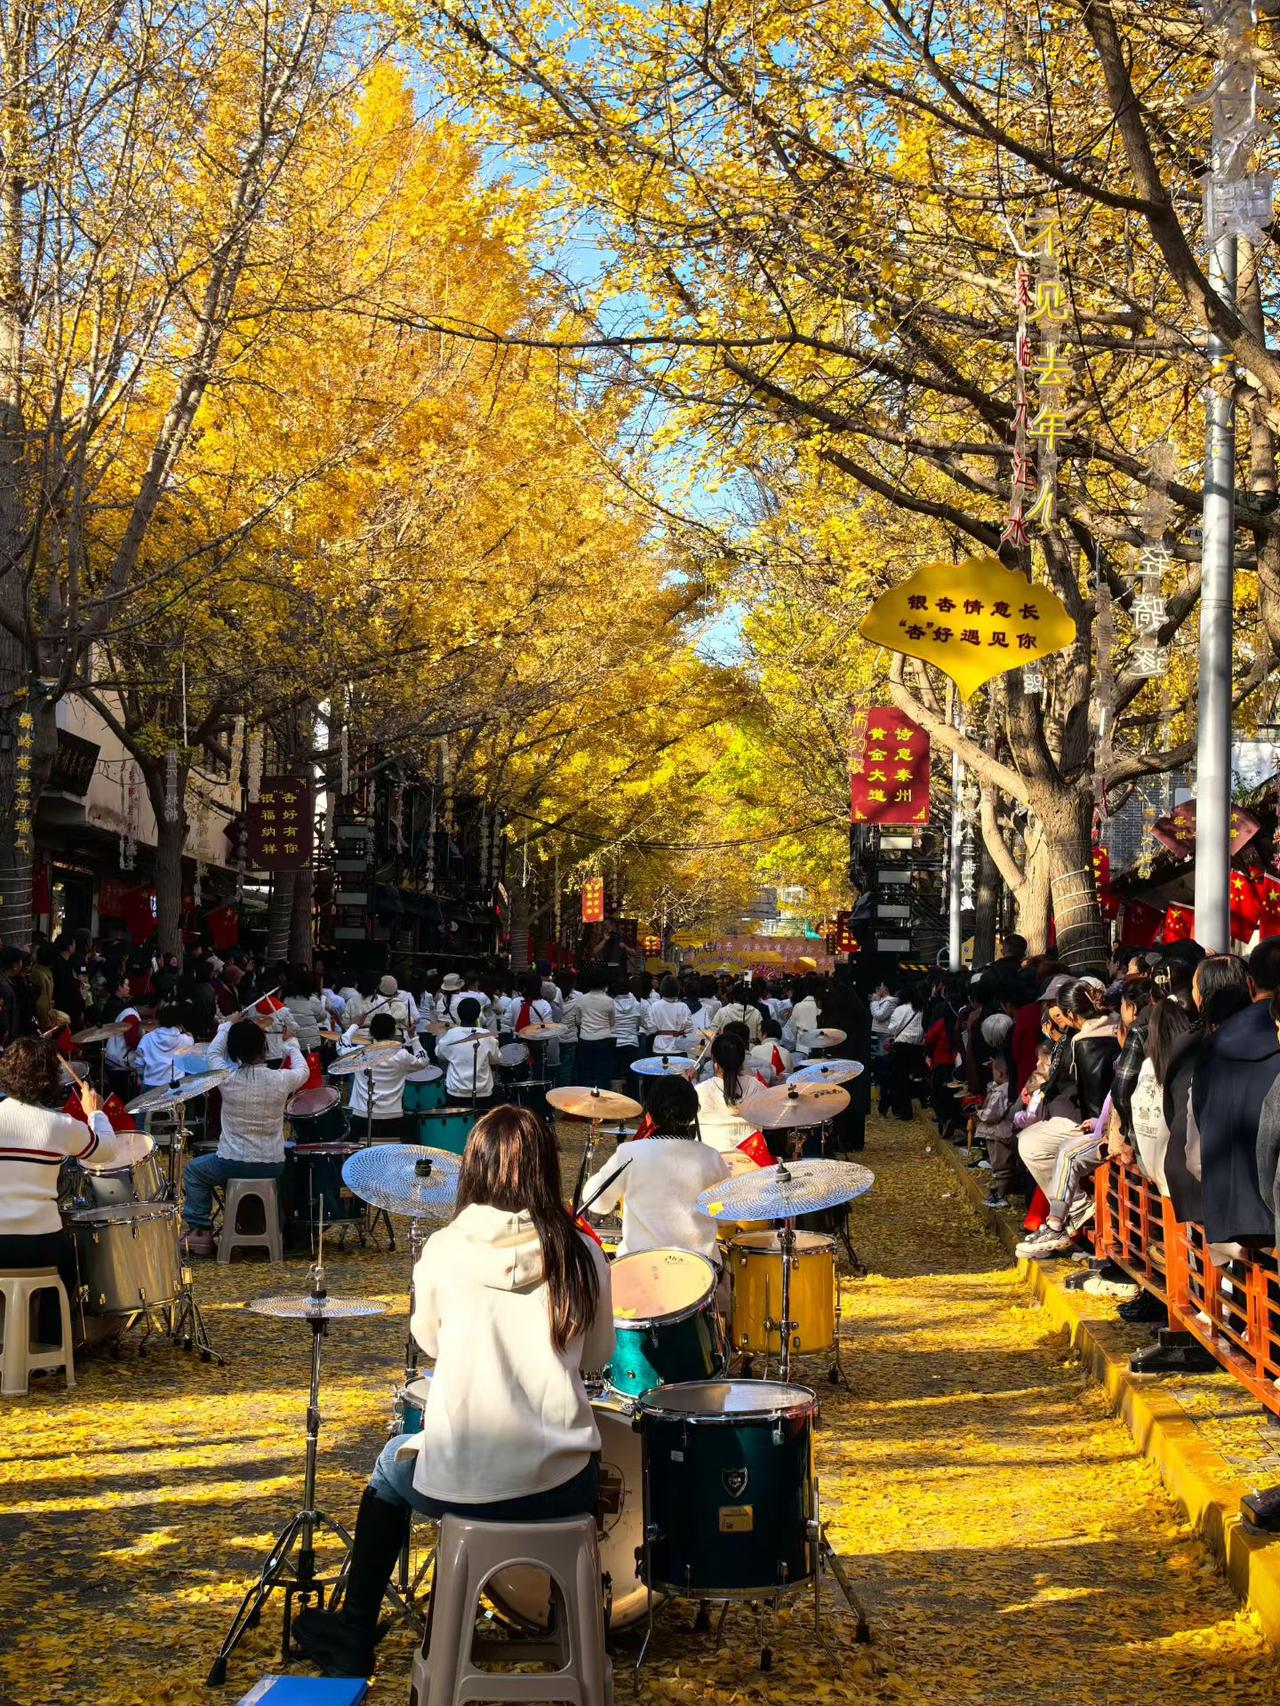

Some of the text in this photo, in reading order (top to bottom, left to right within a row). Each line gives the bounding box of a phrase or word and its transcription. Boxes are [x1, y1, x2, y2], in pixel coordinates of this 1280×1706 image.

[1026, 217, 1073, 530] 不见去年人
[908, 594, 1040, 621] 银杏情意长
[867, 727, 887, 803] 黄金大道
[894, 727, 914, 803] 诗意秦州
